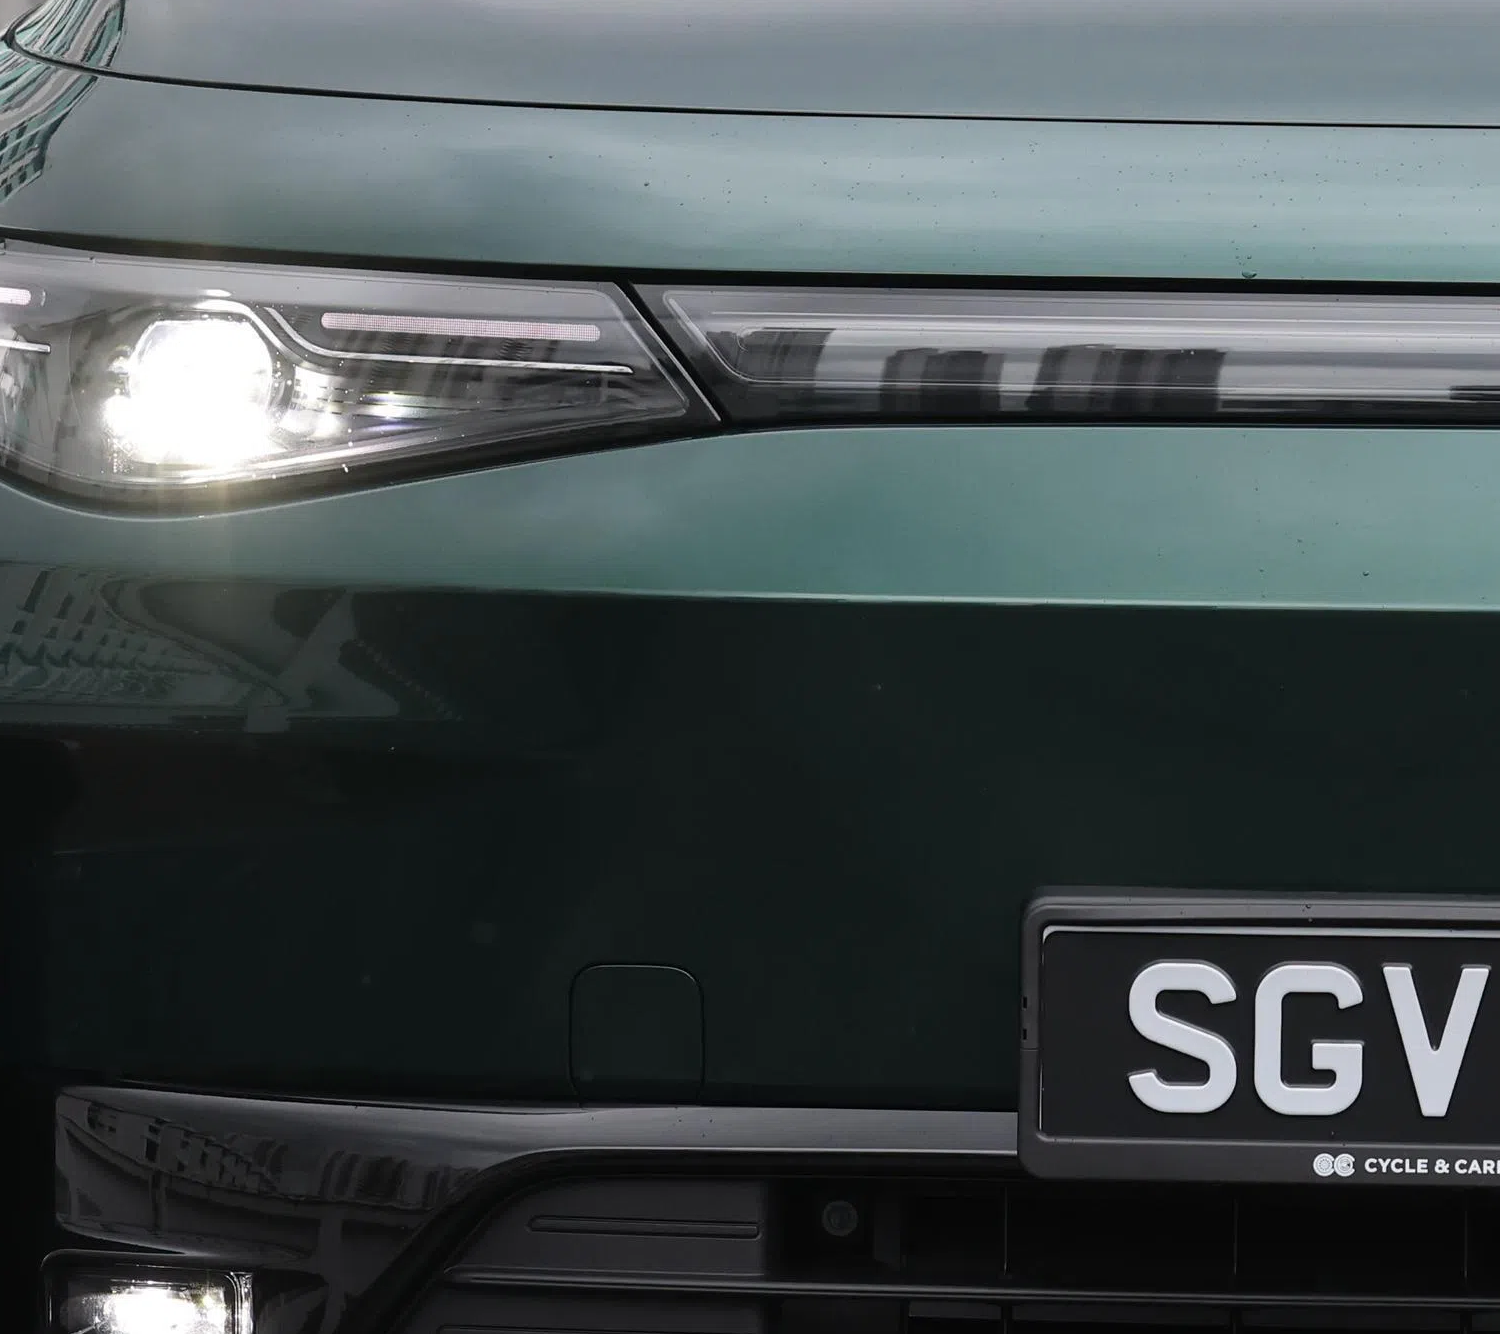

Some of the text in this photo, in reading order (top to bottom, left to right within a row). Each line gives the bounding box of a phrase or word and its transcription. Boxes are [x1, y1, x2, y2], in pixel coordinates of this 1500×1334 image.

[1128, 961, 1491, 1117] SGV
[1364, 1157, 1429, 1174] CYCLE
[1434, 1158, 1450, 1174] &
